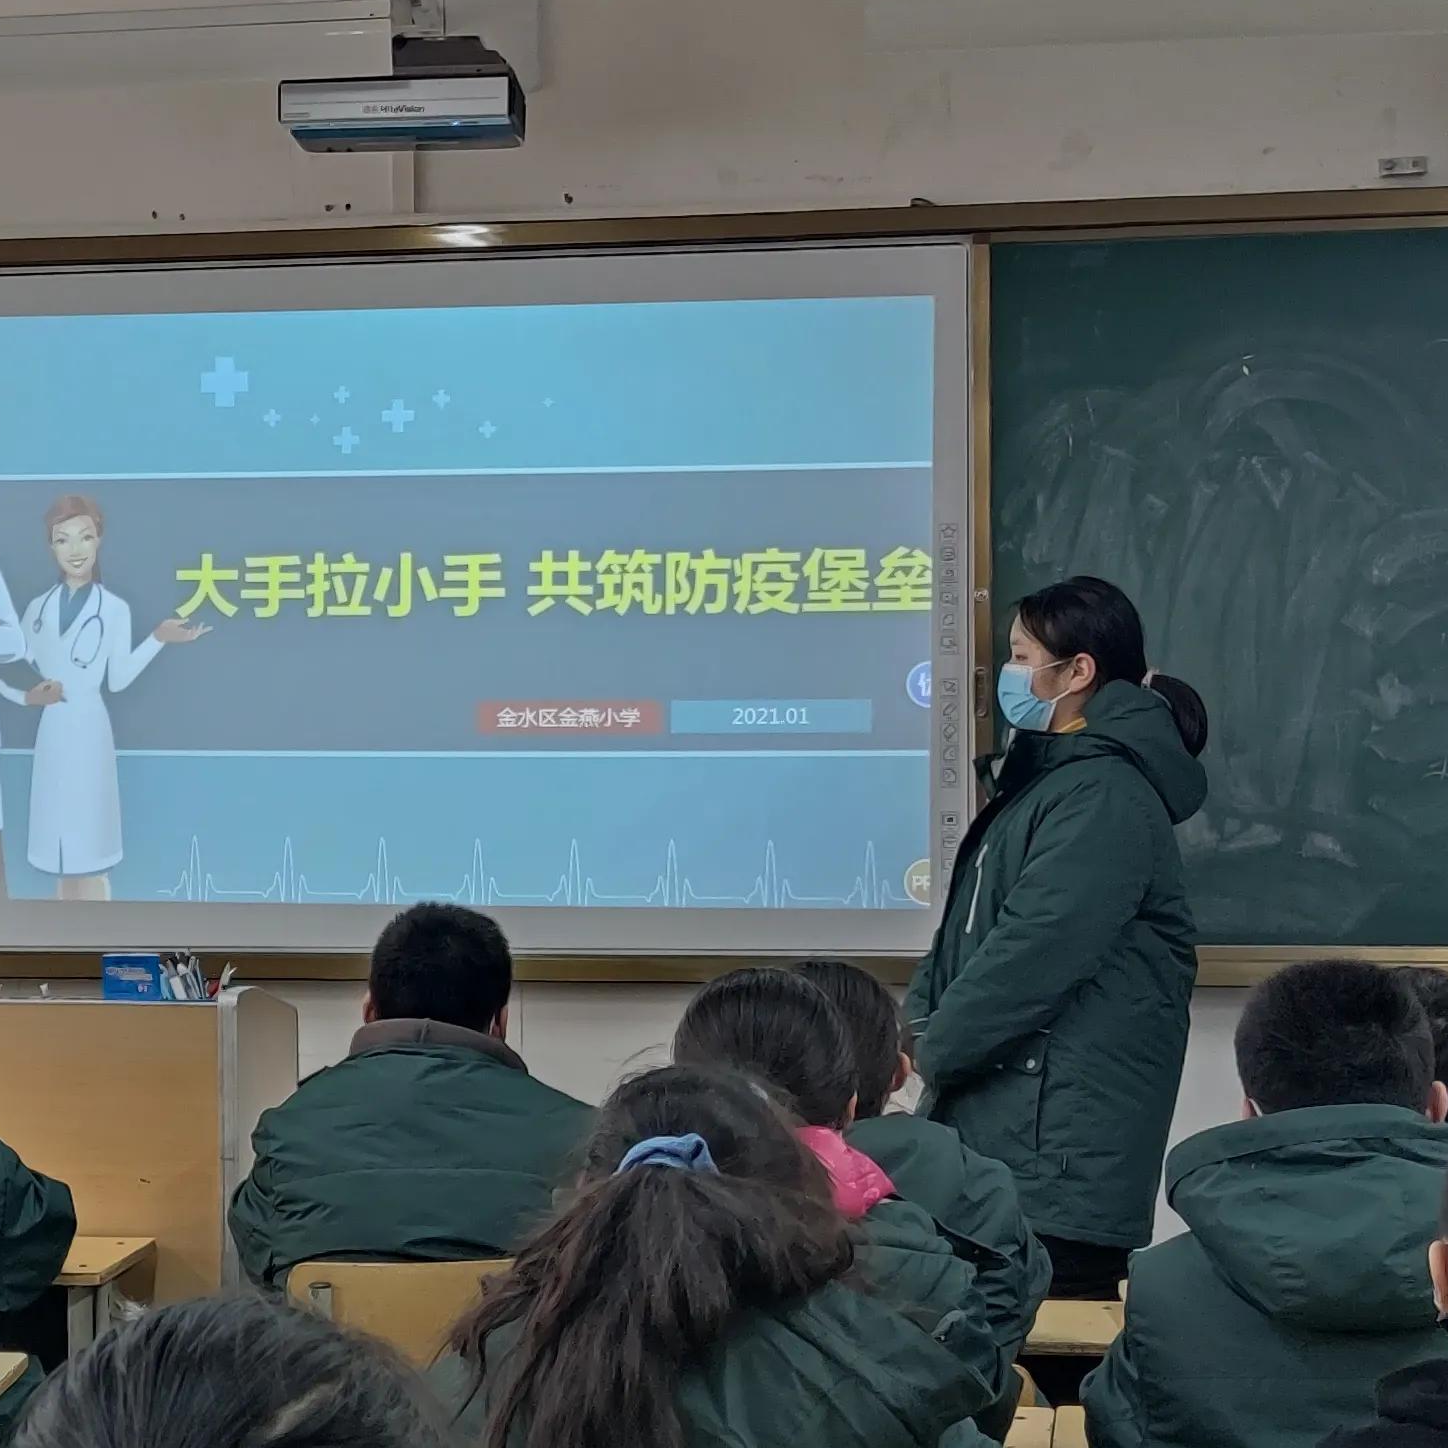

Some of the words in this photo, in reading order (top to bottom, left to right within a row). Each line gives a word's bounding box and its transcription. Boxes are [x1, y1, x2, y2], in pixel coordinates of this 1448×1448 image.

[175, 551, 506, 618] 大手拉小手
[526, 546, 933, 616] 共筑防疫堡垒
[496, 706, 641, 728] 金水区金燕小学
[732, 707, 810, 726] 2021.01
